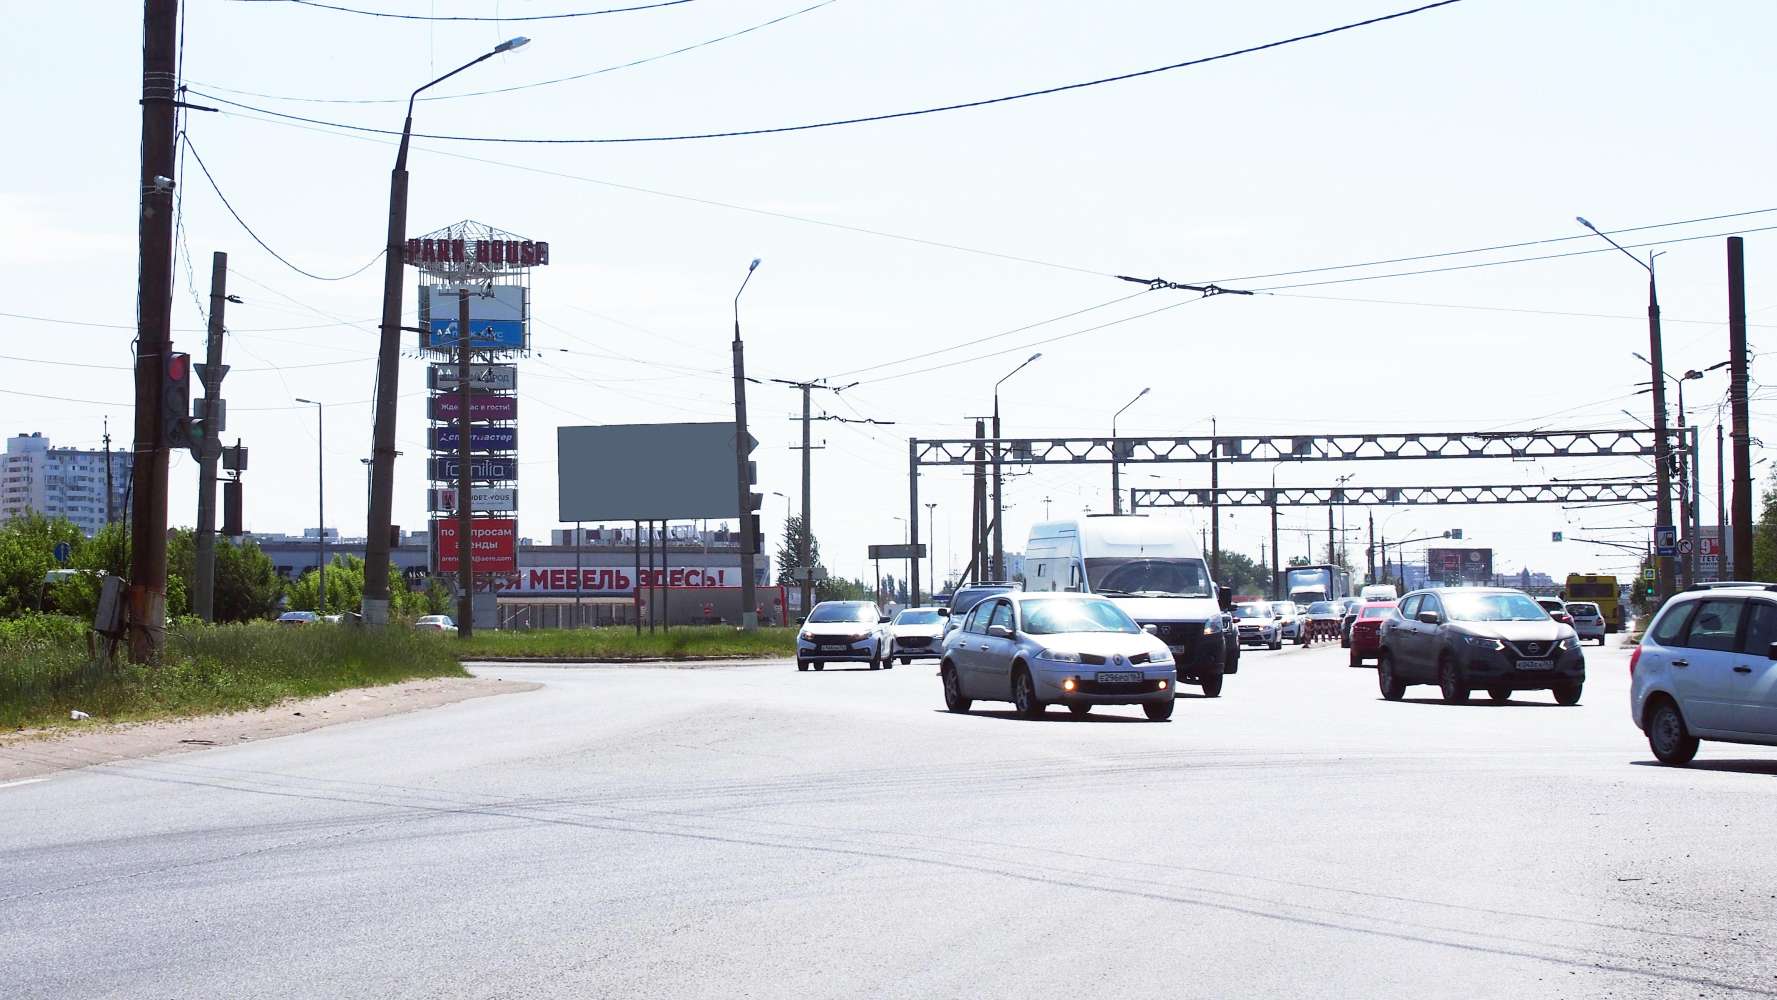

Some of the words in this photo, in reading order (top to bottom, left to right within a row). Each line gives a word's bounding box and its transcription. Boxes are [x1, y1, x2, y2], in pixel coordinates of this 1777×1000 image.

[408, 239, 464, 262] PARK
[477, 240, 549, 265] HOUSE
[449, 433, 513, 442] сптмастер
[471, 529, 512, 537] просам
[530, 570, 630, 590] МЕБЕЛЬ
[639, 569, 724, 587] ЗДЕСЬ!
